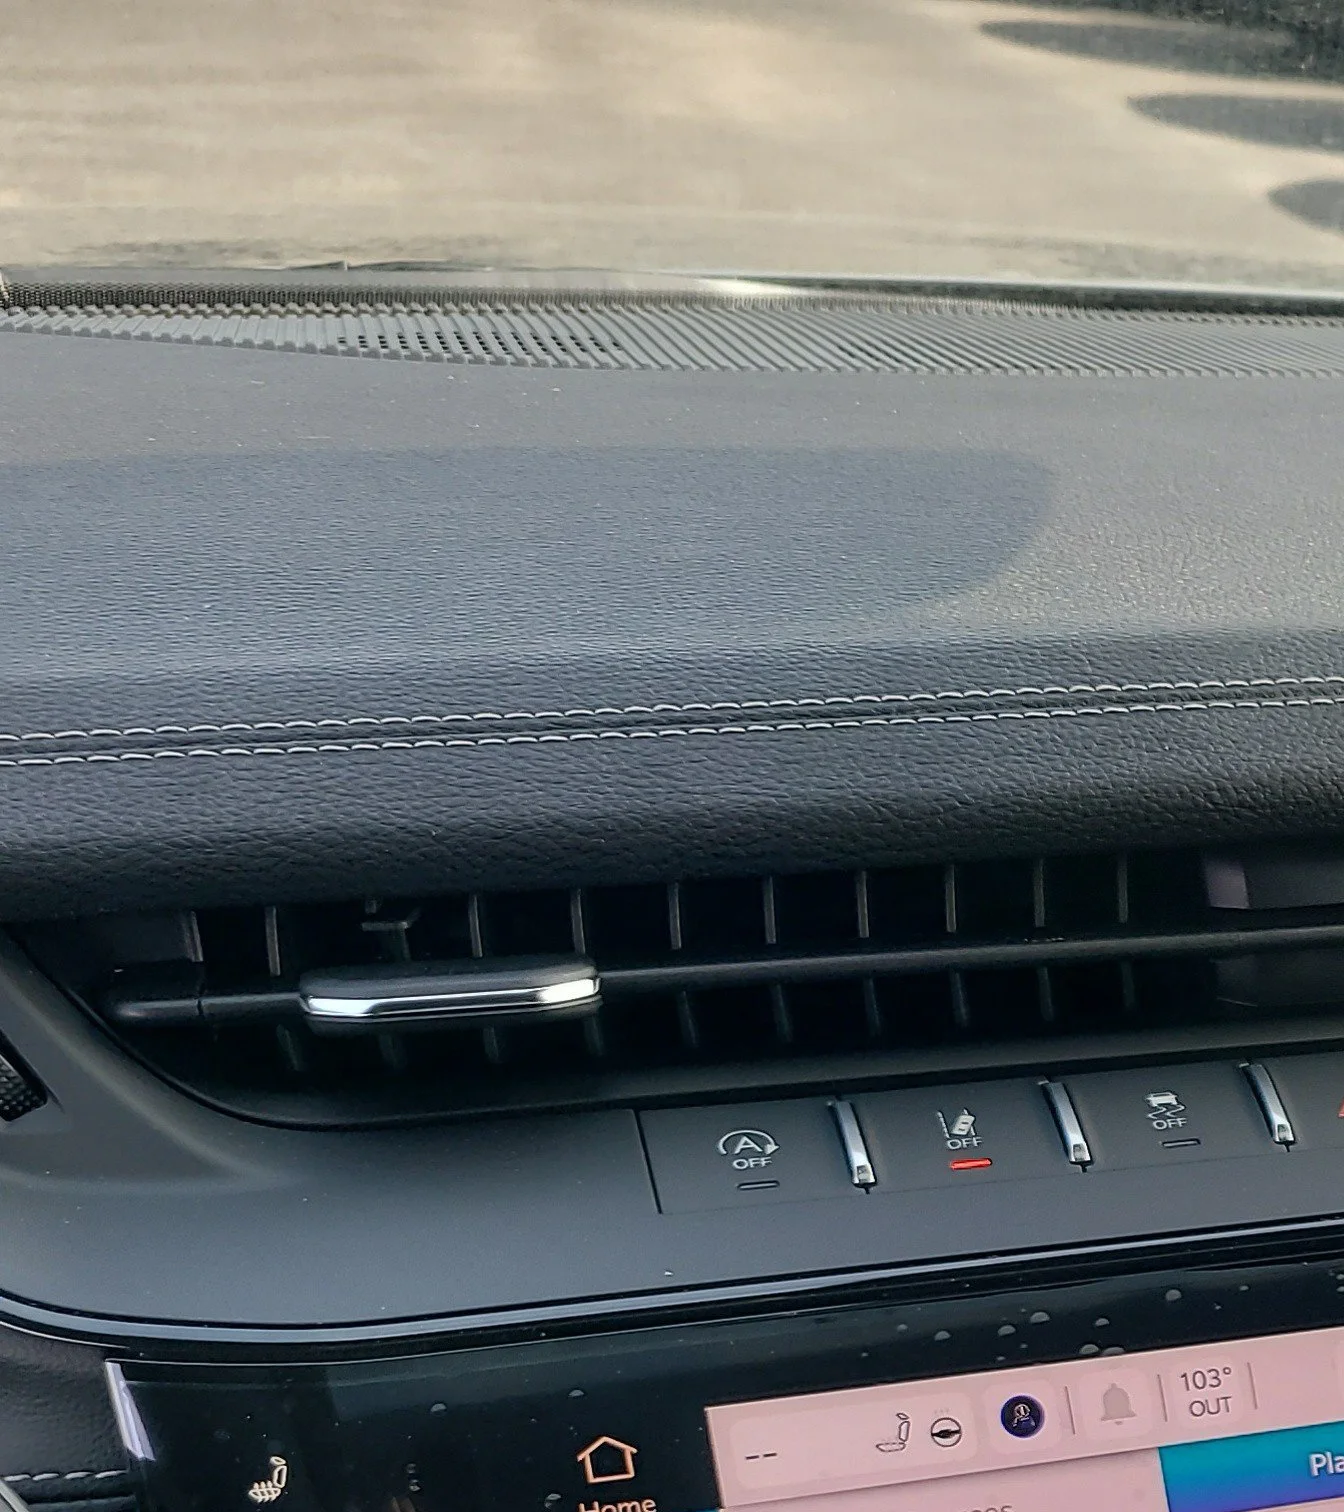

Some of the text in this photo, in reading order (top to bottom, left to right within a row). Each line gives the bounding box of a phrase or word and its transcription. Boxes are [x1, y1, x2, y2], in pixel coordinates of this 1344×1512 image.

[1153, 1117, 1187, 1131] OFF
[947, 1137, 983, 1150] OFF
[732, 1156, 772, 1170] OFF
[1180, 1367, 1232, 1393] 103°
[1189, 1395, 1233, 1418] OUT
